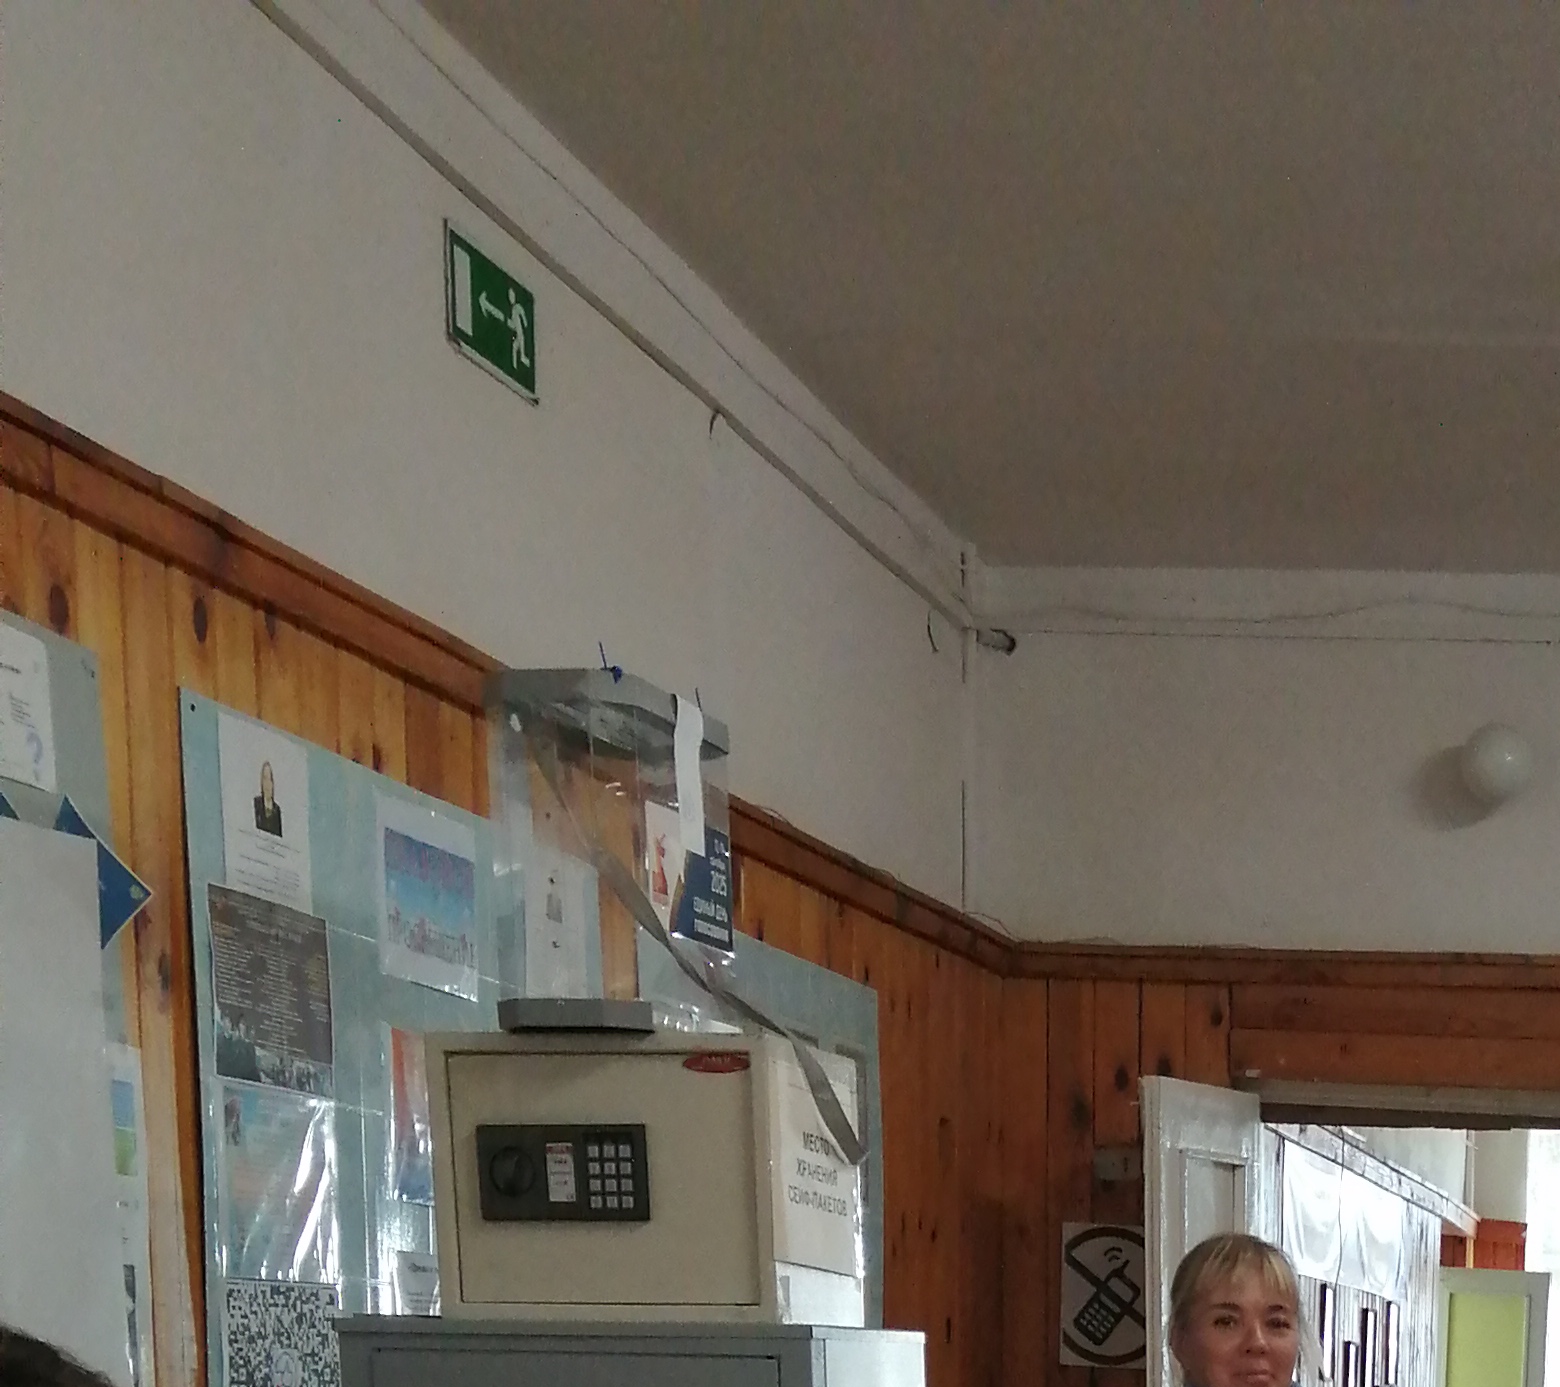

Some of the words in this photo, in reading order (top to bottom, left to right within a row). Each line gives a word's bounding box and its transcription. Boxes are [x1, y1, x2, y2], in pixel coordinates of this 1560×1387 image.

[710, 869, 728, 897] 2025
[802, 1130, 830, 1152] МЕСТО
[796, 1157, 838, 1187] ХРАНЕНИЯ
